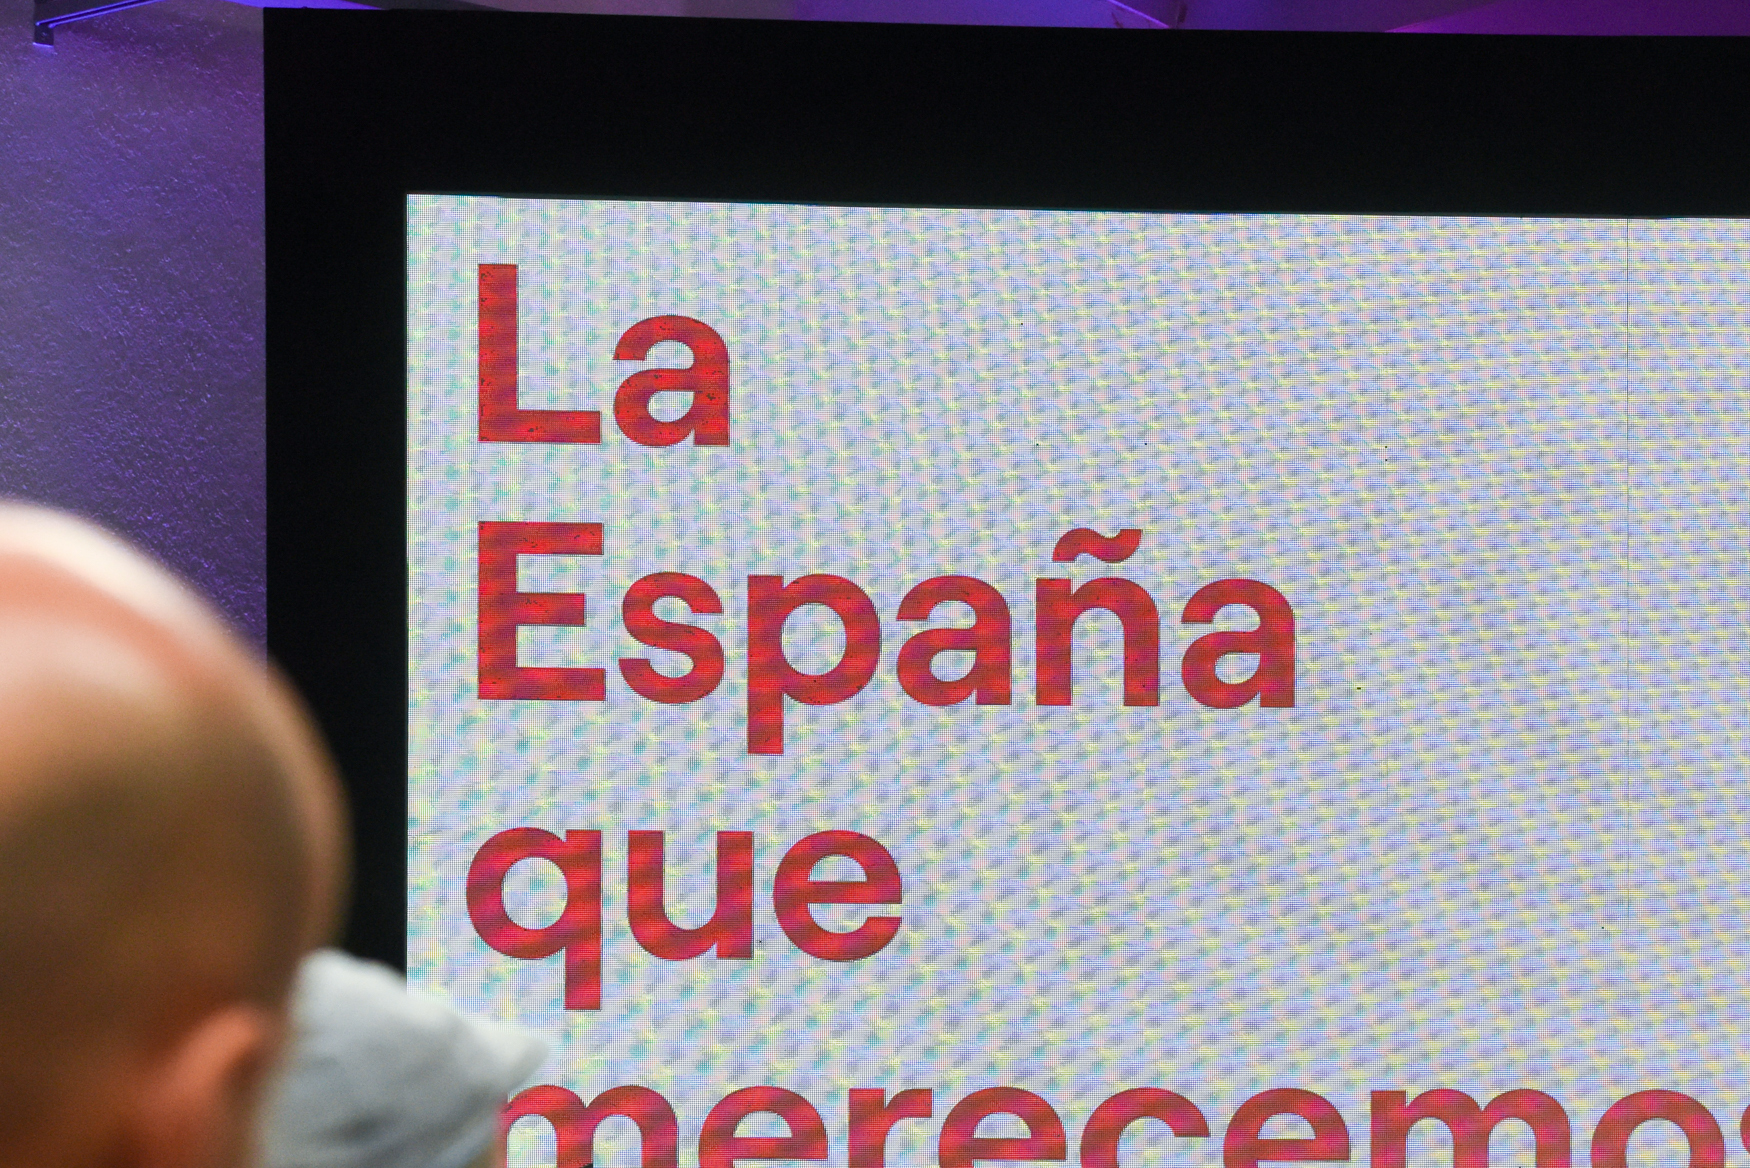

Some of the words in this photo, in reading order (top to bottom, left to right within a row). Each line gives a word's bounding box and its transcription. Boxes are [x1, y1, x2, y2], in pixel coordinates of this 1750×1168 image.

[478, 264, 731, 447] La
[477, 521, 1296, 755] España
[467, 826, 901, 1010] que
